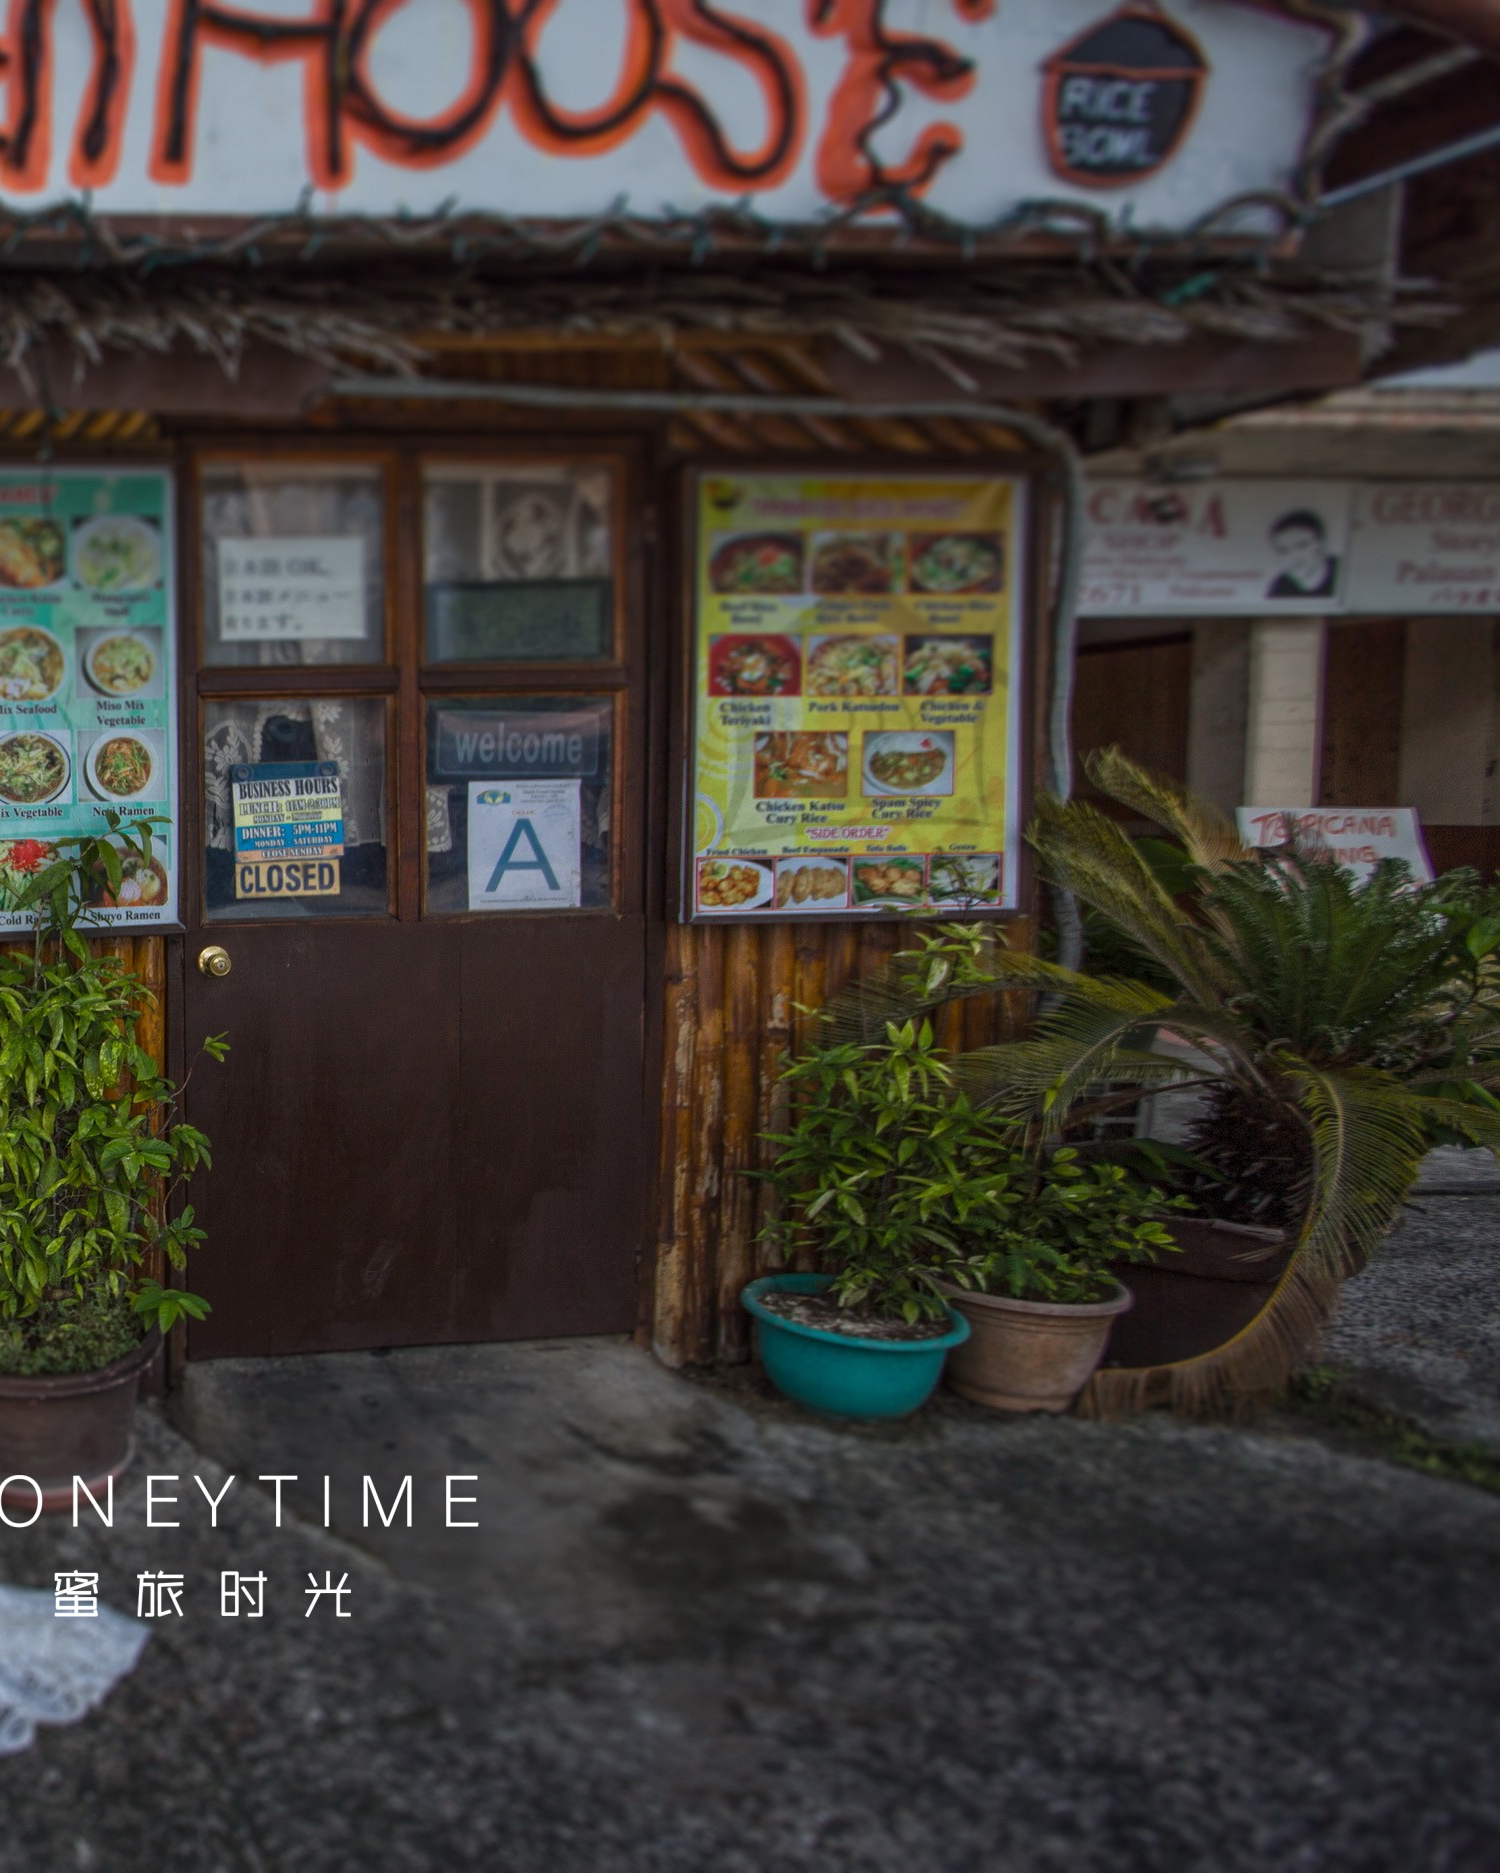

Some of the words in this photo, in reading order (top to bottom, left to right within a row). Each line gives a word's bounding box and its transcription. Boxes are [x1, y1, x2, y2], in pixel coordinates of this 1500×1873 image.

[1060, 78, 1156, 120] RICE
[1057, 125, 1157, 166] BOWL
[16, 703, 57, 715] Seafood
[97, 700, 121, 712] Miso
[124, 699, 145, 711] Mix
[719, 702, 771, 713] Chicken
[808, 702, 837, 712] Pork
[920, 701, 972, 712] Chicken
[97, 715, 146, 727] Vegetable
[720, 713, 772, 727] Teriyaki
[920, 713, 978, 725] Vegetable
[455, 722, 582, 763] welcome
[240, 780, 291, 800] BUSINESS
[295, 778, 338, 796] HOURS
[13, 807, 63, 819] Vegetable
[93, 806, 116, 816] Nei
[119, 806, 155, 816] Ramen
[240, 801, 283, 815] LUNCH:
[755, 802, 804, 812] Chicken
[253, 814, 285, 824] MONDAY
[801, 813, 827, 823] Rice
[906, 809, 932, 819] Rice
[243, 827, 285, 840] DINNER:
[292, 822, 337, 835] 5PM-11PM
[254, 839, 285, 848] MONDAY
[294, 836, 333, 845] SATURDAY
[262, 849, 288, 857] CLOSE
[289, 846, 323, 855] SUNDAY
[485, 818, 560, 892] A
[240, 863, 335, 893] CLOSED
[126, 911, 160, 920] Ramen
